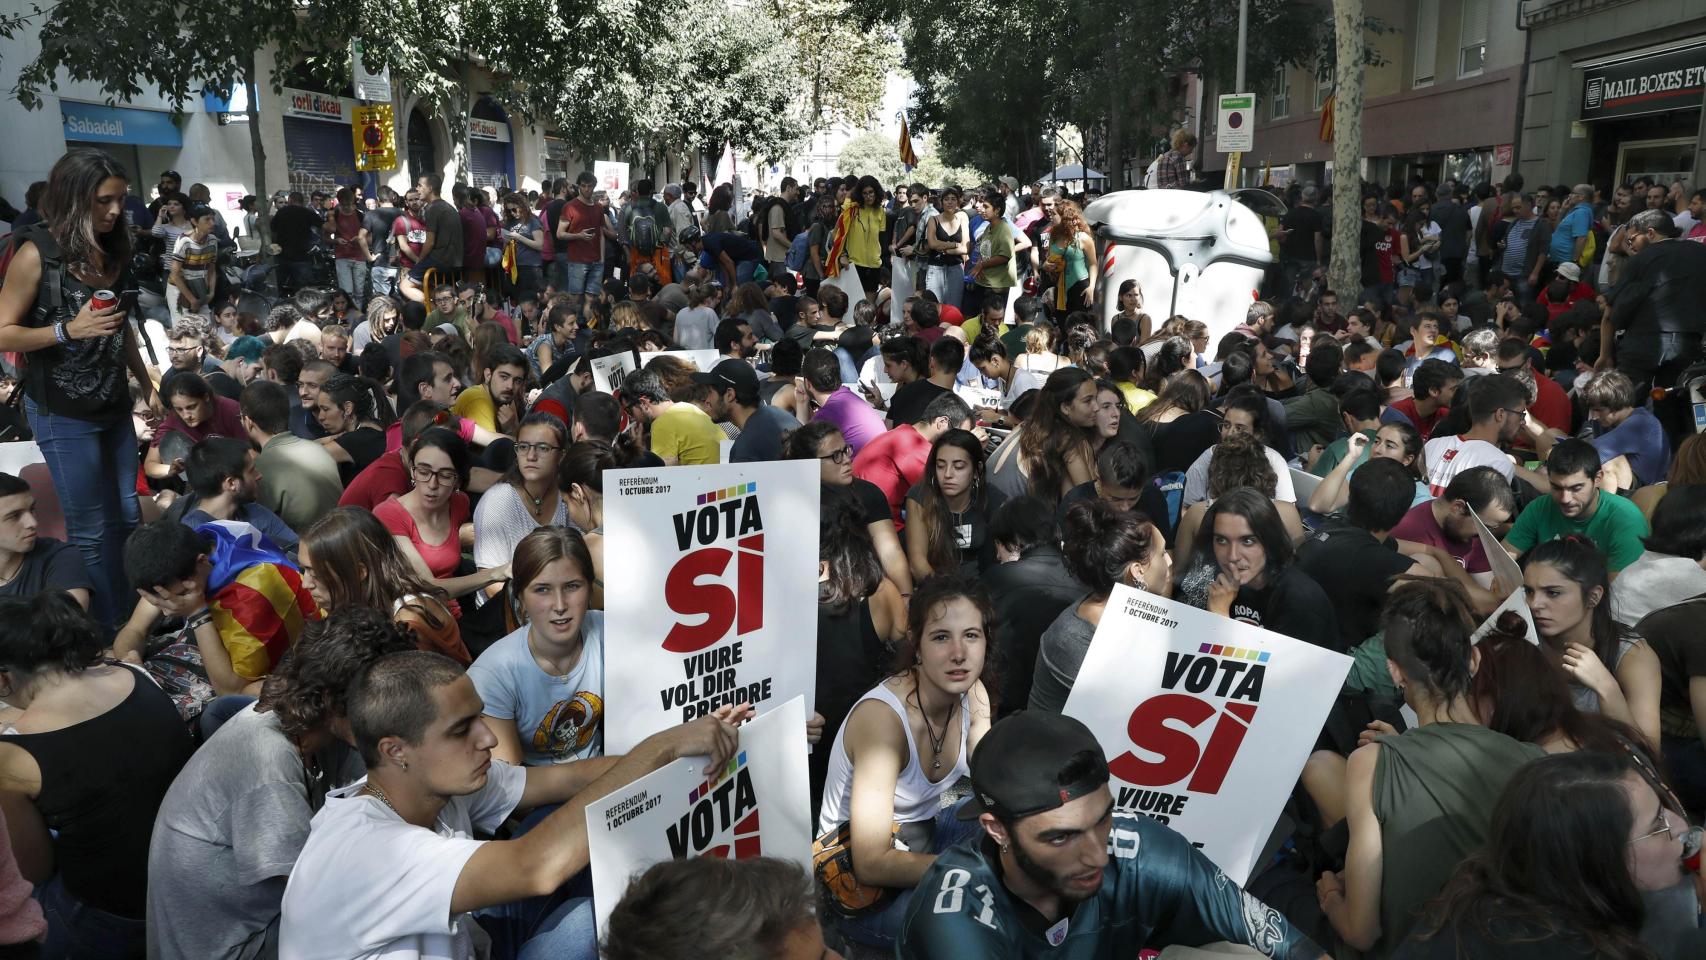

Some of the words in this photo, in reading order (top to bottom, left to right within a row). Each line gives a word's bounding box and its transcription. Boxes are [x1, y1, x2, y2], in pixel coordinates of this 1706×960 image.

[1604, 78, 1637, 100] MAIL
[1638, 69, 1683, 95] BOXES
[291, 92, 313, 112] sorli
[313, 94, 342, 116] discau
[68, 115, 124, 137] Sabadell
[619, 476, 659, 486] REFERÈNDUM
[619, 488, 623, 496] 1
[625, 486, 654, 496] OCTUBRE
[655, 485, 671, 494] 2017
[672, 494, 764, 552] VOTA
[661, 533, 764, 653] SÍ
[1126, 597, 1169, 616] REFERÈNDUM
[1123, 606, 1128, 614] 1
[1128, 607, 1160, 624] OCTUBRE
[1160, 618, 1179, 630] 2017
[683, 641, 743, 680] VIURE
[1161, 651, 1266, 702] VOTA
[660, 681, 700, 711] VOL
[703, 667, 737, 698] DIR
[1107, 693, 1258, 795] SÍ
[605, 789, 648, 820] REFERÈNDUM
[607, 822, 612, 831] 1
[613, 804, 645, 828] OCTUBRE
[645, 794, 662, 811] 2017
[666, 766, 758, 861] VOTA
[1116, 786, 1190, 816] VIURE
[933, 868, 997, 930] 81
